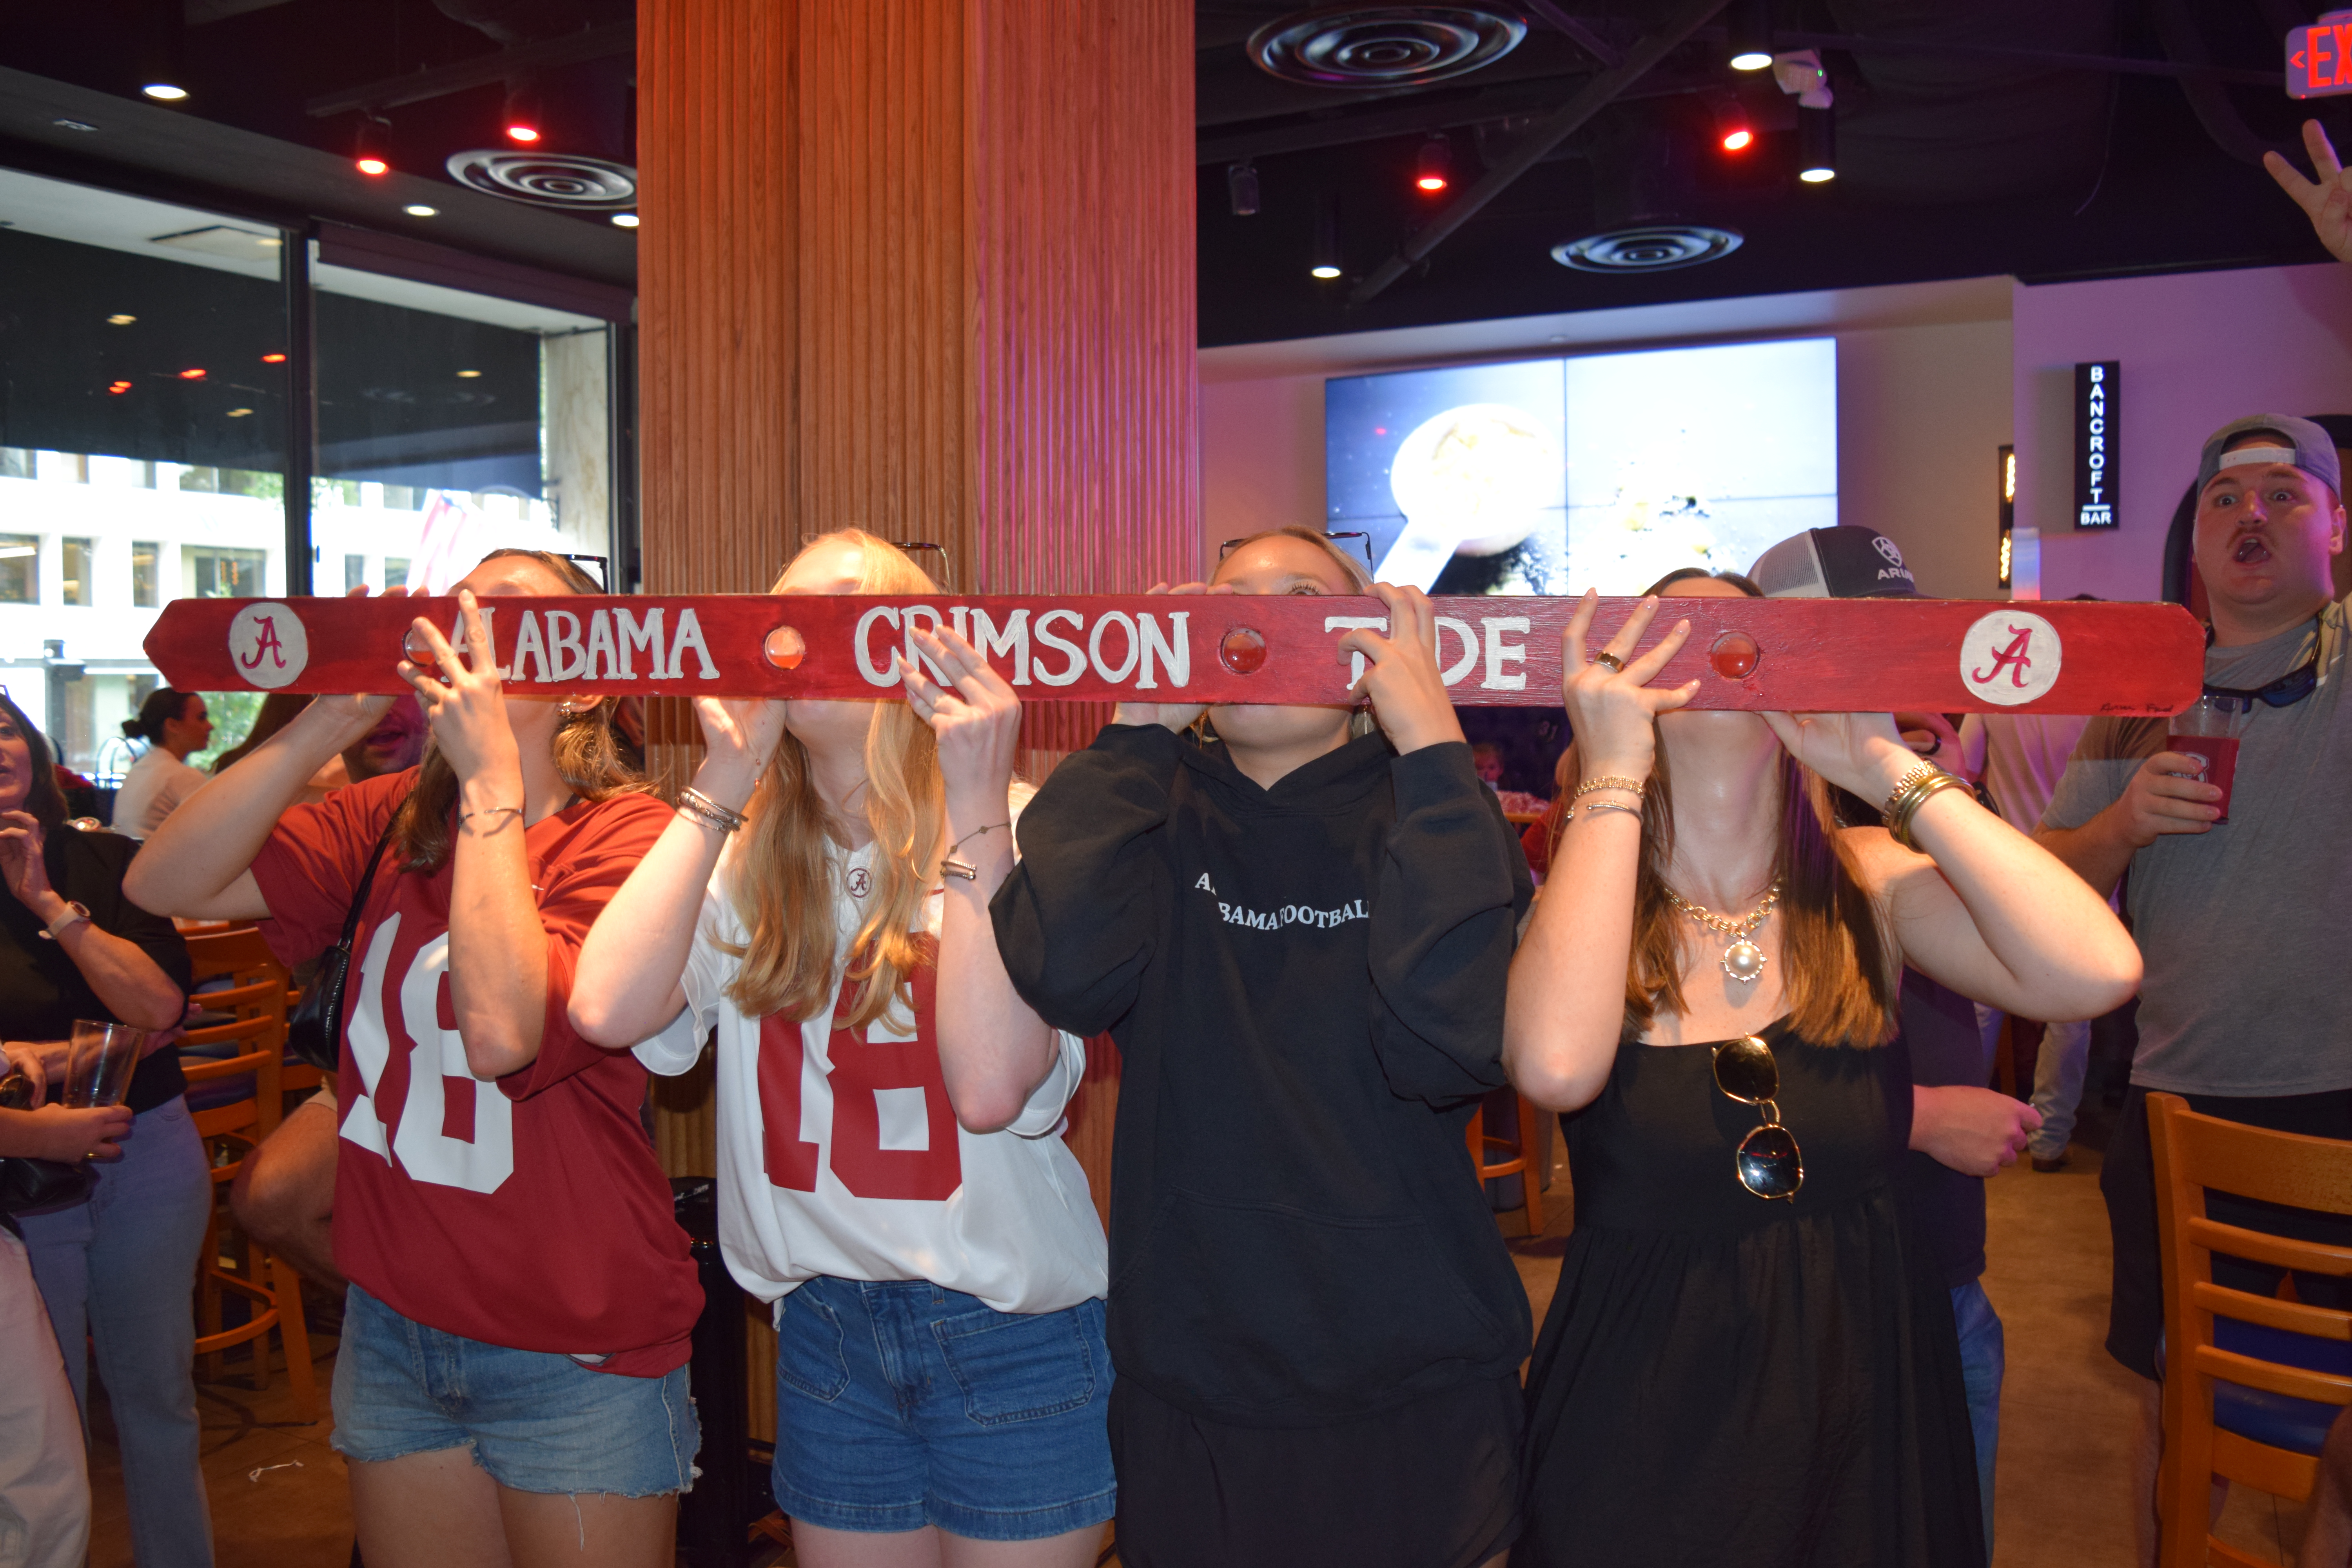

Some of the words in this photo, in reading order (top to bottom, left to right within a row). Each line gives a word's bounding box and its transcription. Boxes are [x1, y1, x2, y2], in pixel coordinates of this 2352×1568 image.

[2089, 365, 2104, 504] BANCROFT
[2080, 512, 2111, 525] BAR
[241, 616, 287, 669] A
[1325, 616, 1530, 690] TDE
[1972, 624, 2033, 688] A
[1194, 872, 1279, 930] ABAMA
[1279, 899, 1370, 928] FOOTBAL
